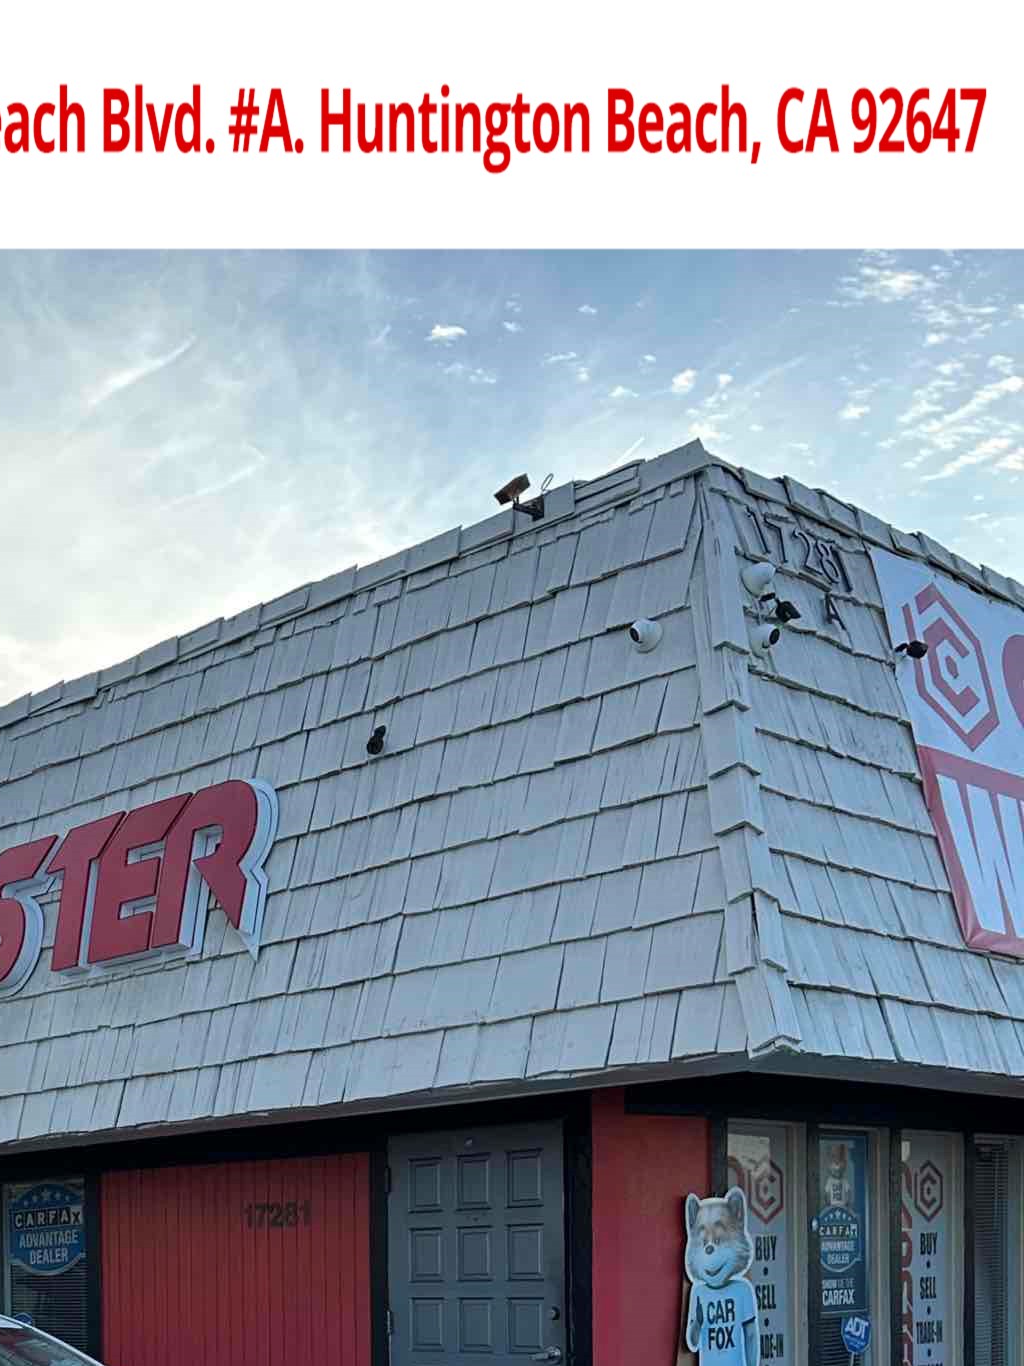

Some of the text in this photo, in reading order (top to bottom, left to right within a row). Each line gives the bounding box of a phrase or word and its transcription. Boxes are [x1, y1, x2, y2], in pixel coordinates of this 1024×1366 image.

[14, 1209, 82, 1228] CARFAX
[19, 1229, 80, 1249] ADVANTAGE
[755, 1236, 777, 1262] BUY
[919, 1232, 938, 1256] BUY
[30, 1247, 69, 1265] DEALER
[755, 1283, 777, 1312] SELL
[822, 1290, 855, 1306] CARFAX
[919, 1276, 937, 1300] SELL
[706, 1297, 736, 1325] CAR
[707, 1326, 736, 1350] FOX
[844, 1317, 869, 1340] ADT
[916, 1320, 943, 1345] TRADE-IN
[760, 1333, 784, 1360] ADE-IN
